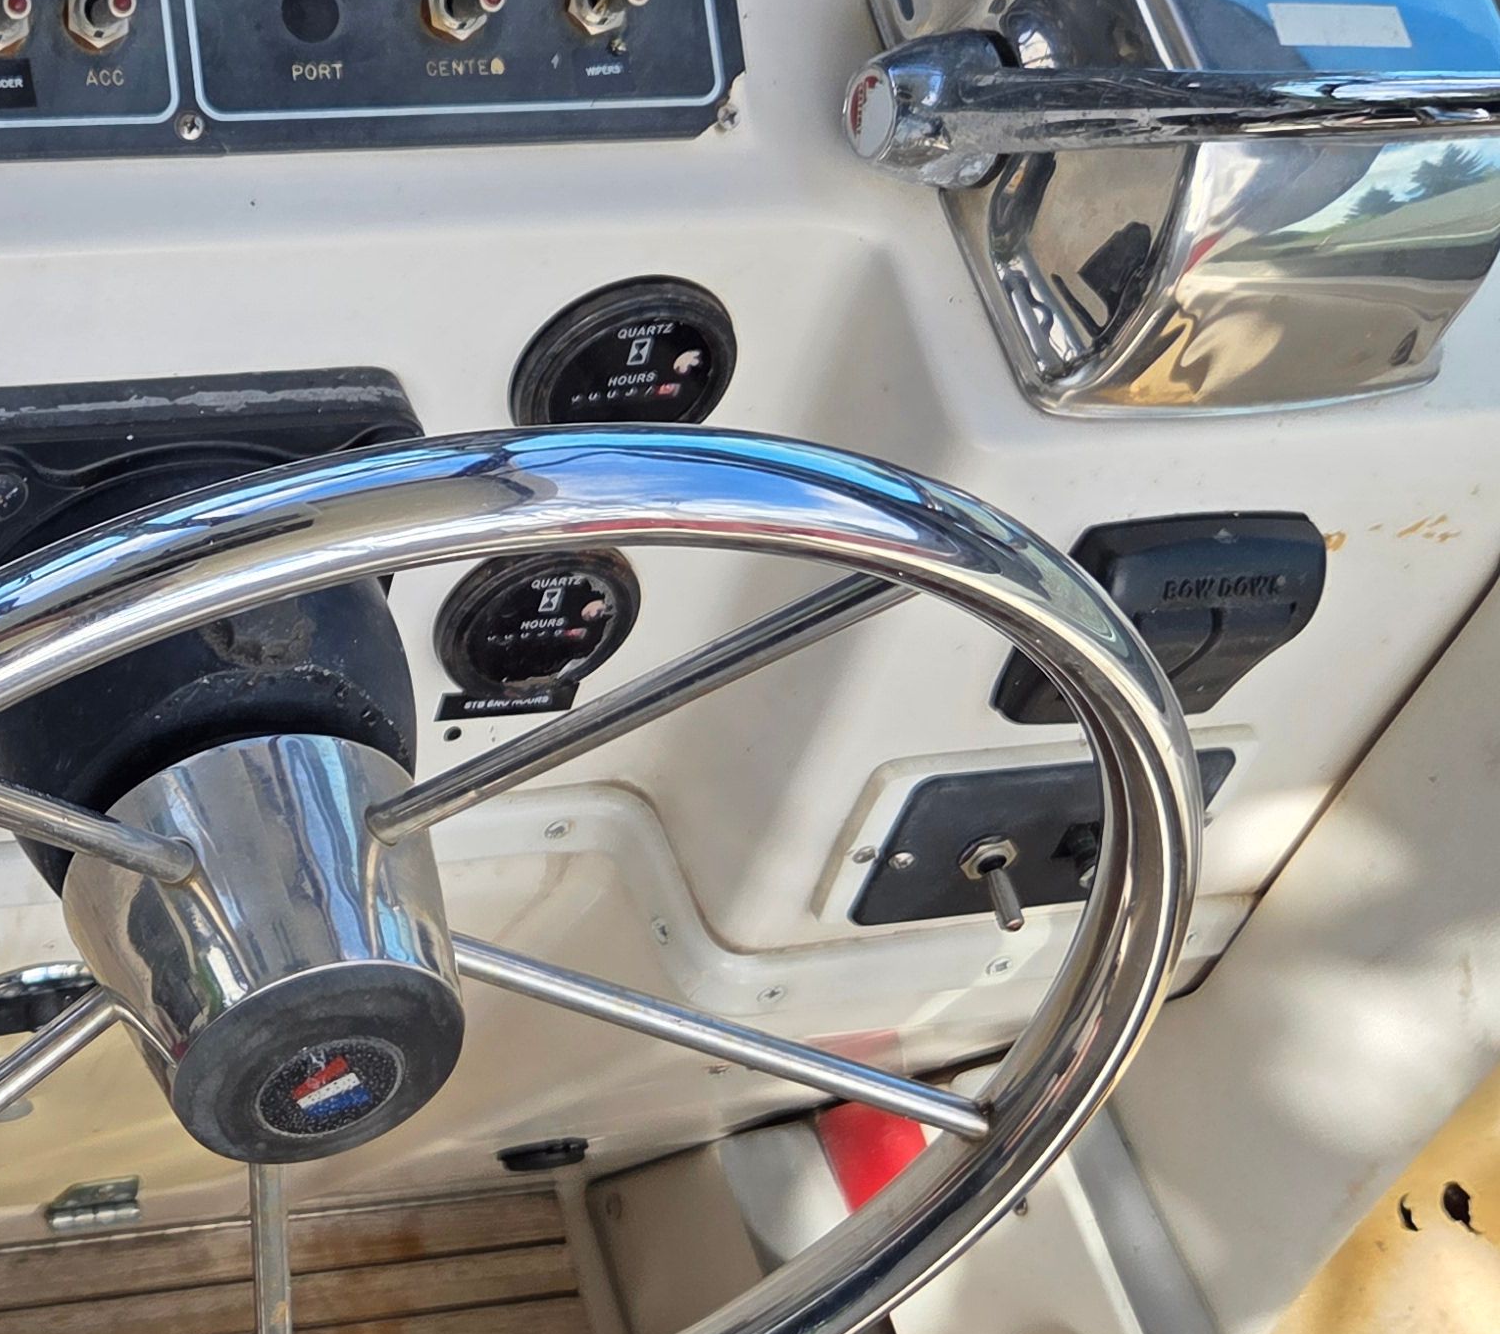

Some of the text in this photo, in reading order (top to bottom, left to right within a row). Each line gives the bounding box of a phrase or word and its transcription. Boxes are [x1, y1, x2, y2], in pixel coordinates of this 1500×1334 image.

[85, 69, 125, 87] ACC
[292, 62, 344, 82] PORT
[617, 323, 675, 340] QUARTZ
[608, 372, 656, 387] HOURS
[531, 575, 582, 589] QUARTZ
[1162, 577, 1215, 601] BOW
[520, 618, 565, 630] HOURS
